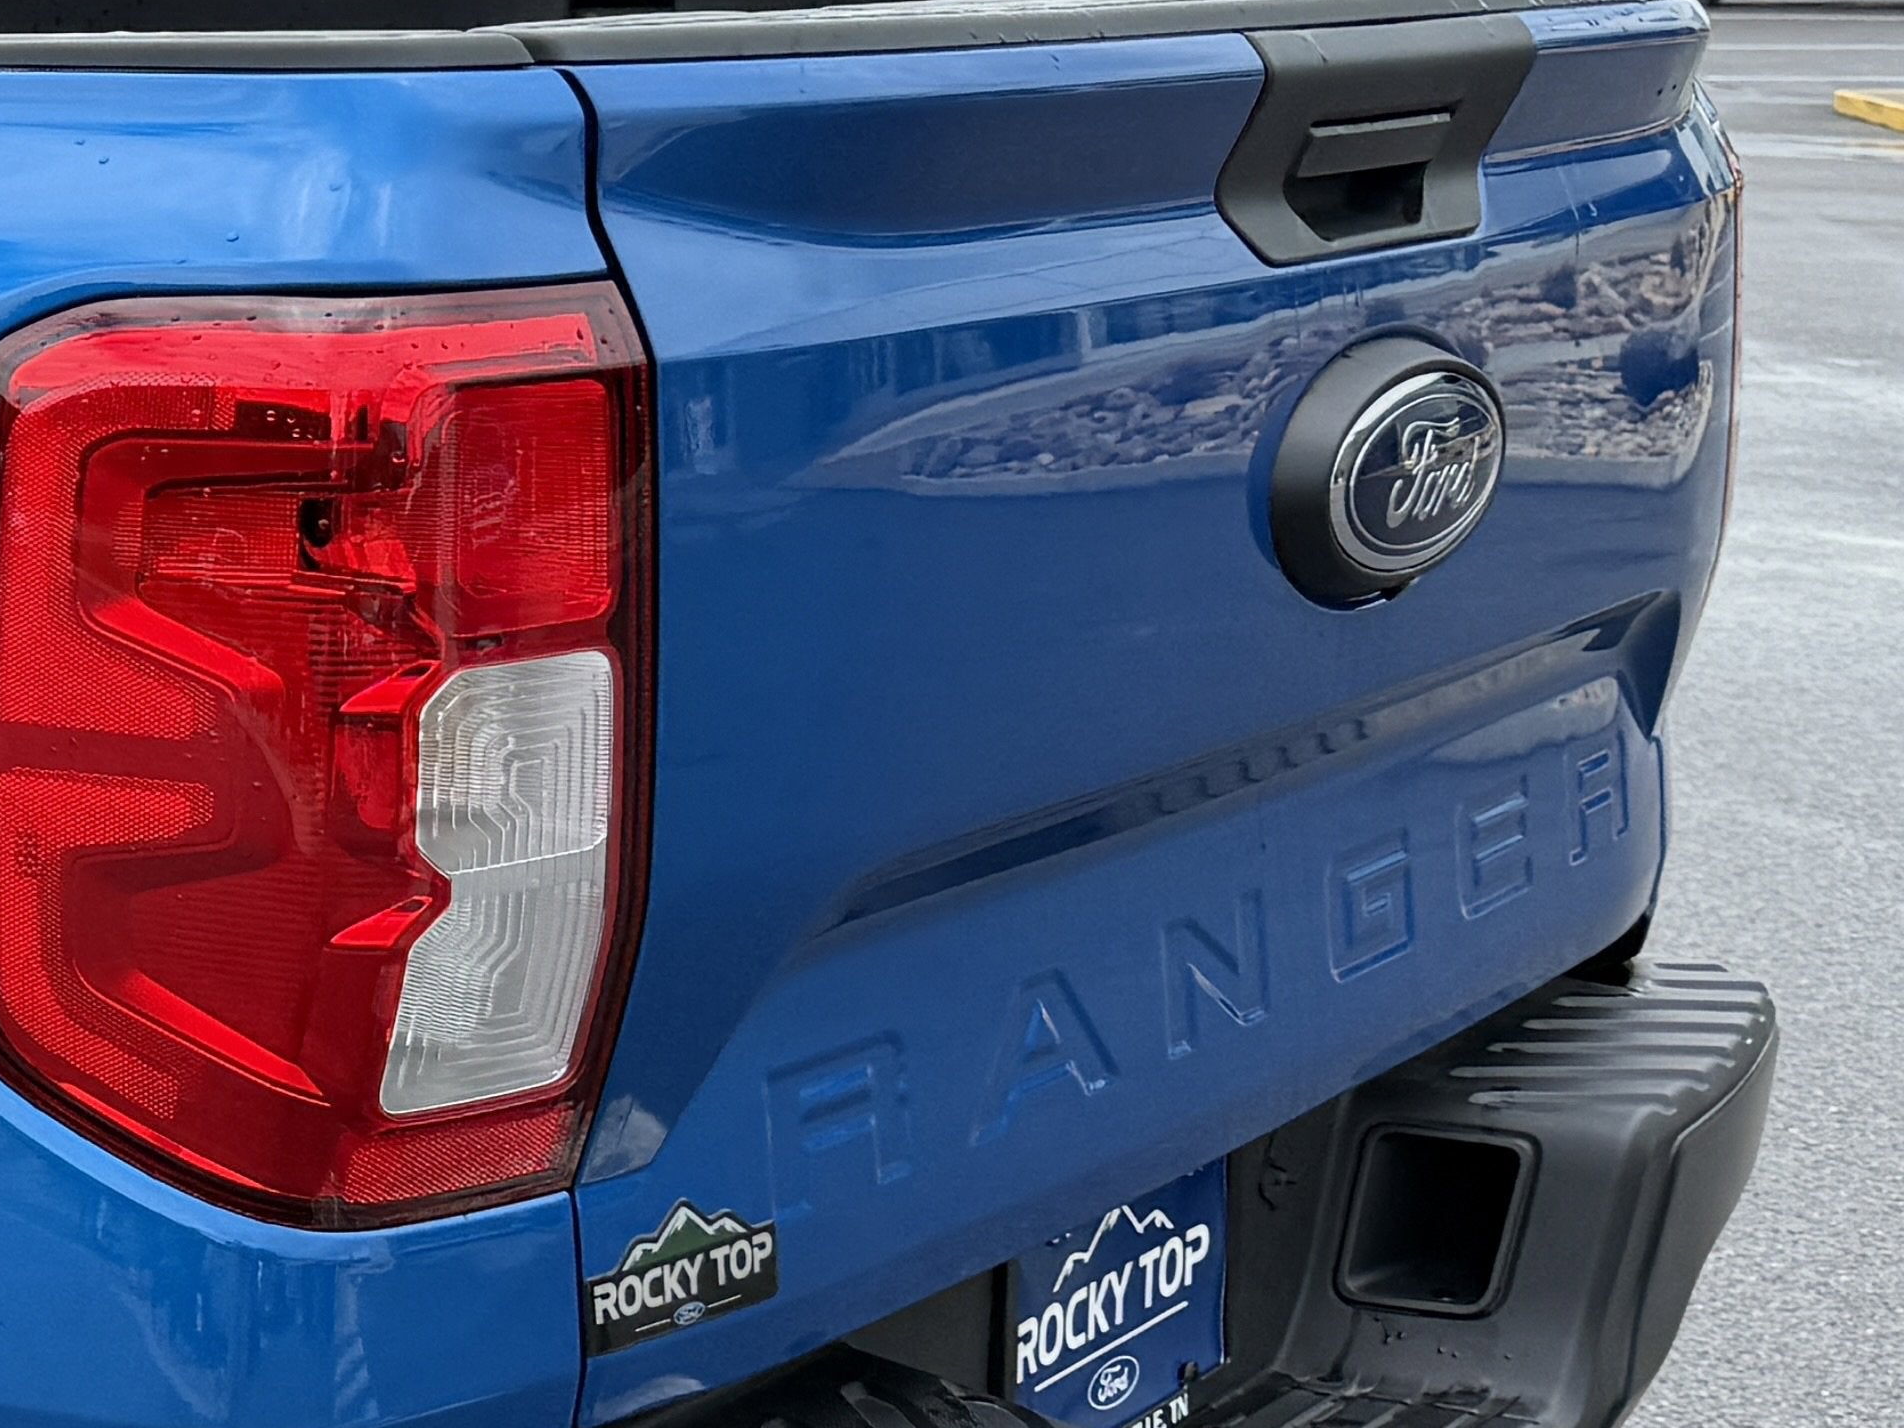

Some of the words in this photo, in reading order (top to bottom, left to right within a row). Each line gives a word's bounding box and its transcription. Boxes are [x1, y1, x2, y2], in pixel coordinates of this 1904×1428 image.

[1385, 416, 1481, 529] Ford
[761, 728, 1630, 1222] RANGER
[593, 1253, 705, 1325] ROCKY
[710, 1231, 774, 1286] TOP
[1015, 1260, 1134, 1385] ROCKY
[1138, 1223, 1210, 1309] TOP
[1095, 1362, 1131, 1404] Ford
[1168, 1392, 1189, 1425] TN
